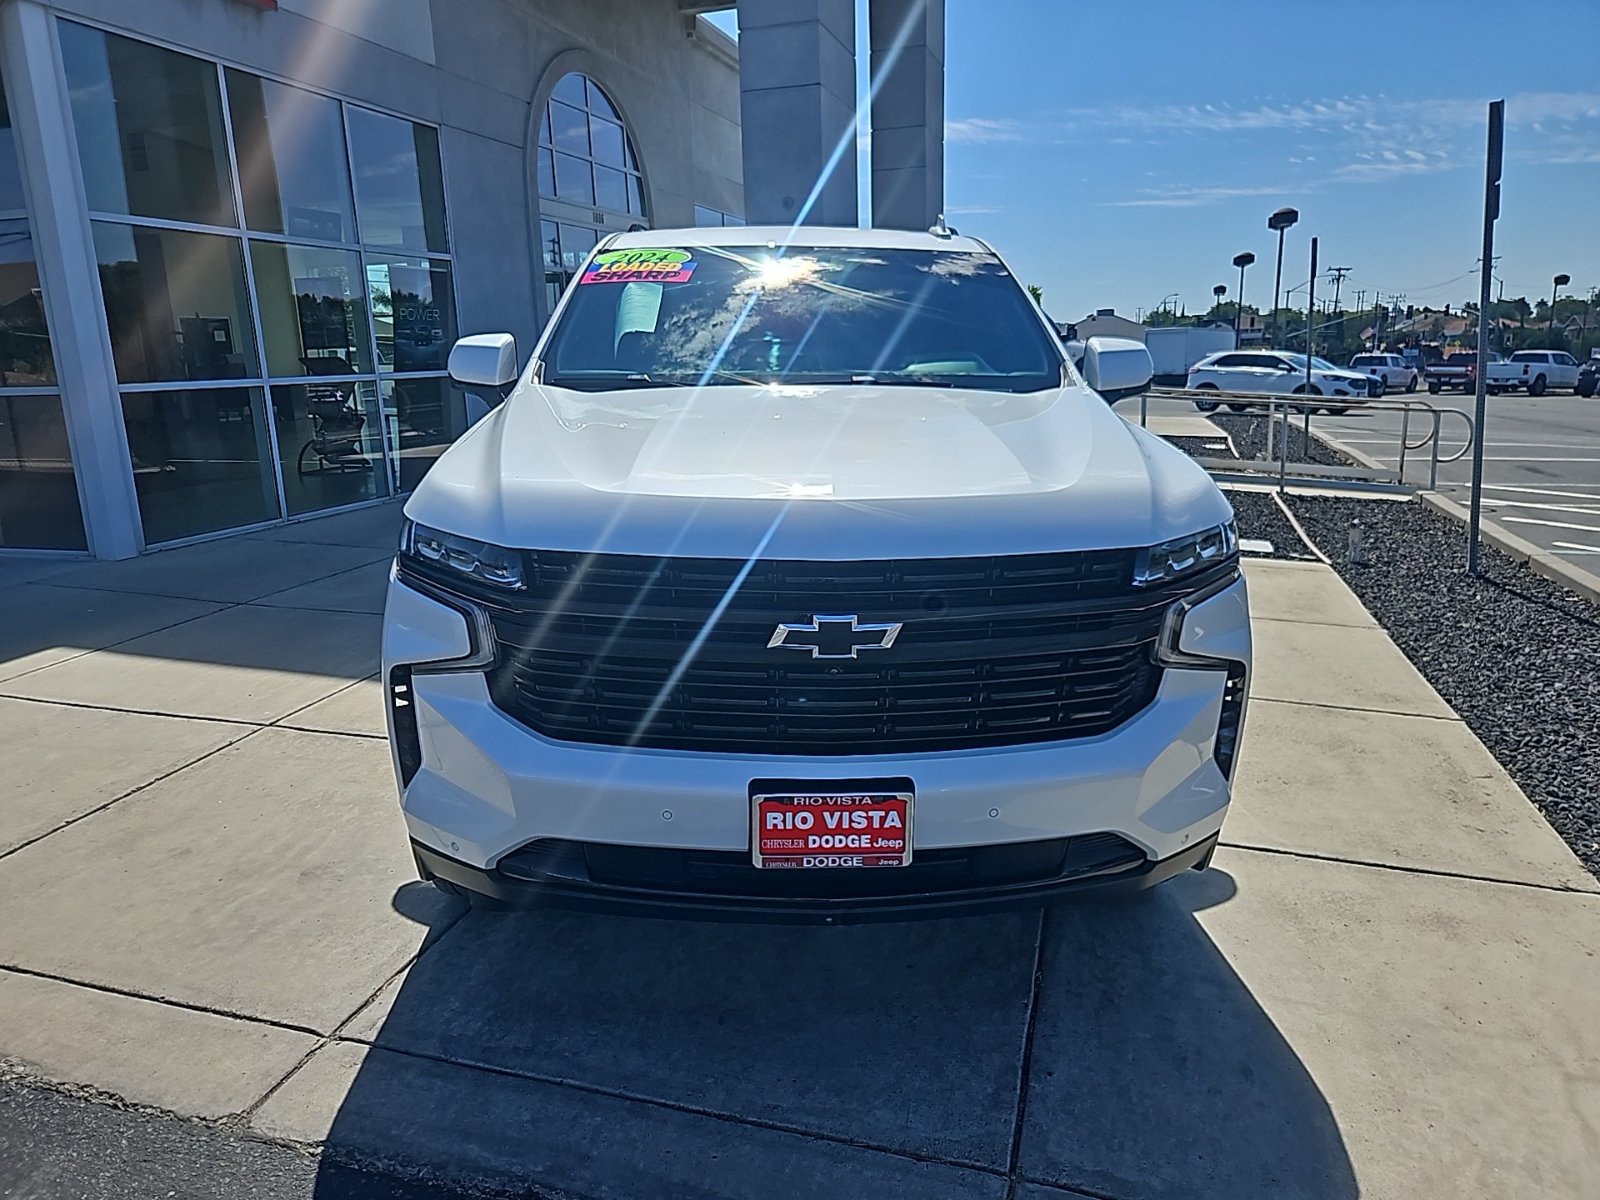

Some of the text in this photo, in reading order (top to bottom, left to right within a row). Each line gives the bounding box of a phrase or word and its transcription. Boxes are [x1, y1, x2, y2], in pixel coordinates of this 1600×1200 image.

[619, 252, 671, 263] 2024
[599, 262, 682, 272] LOADED
[591, 271, 681, 281] SHARP
[400, 308, 440, 321] POWER
[793, 796, 872, 806] RIO VISTA
[766, 810, 902, 830] RIO VISTA
[761, 834, 903, 849] CHRYSLER DODGE Jeep
[803, 857, 863, 867] DODGE
[878, 859, 900, 867] Jeep
